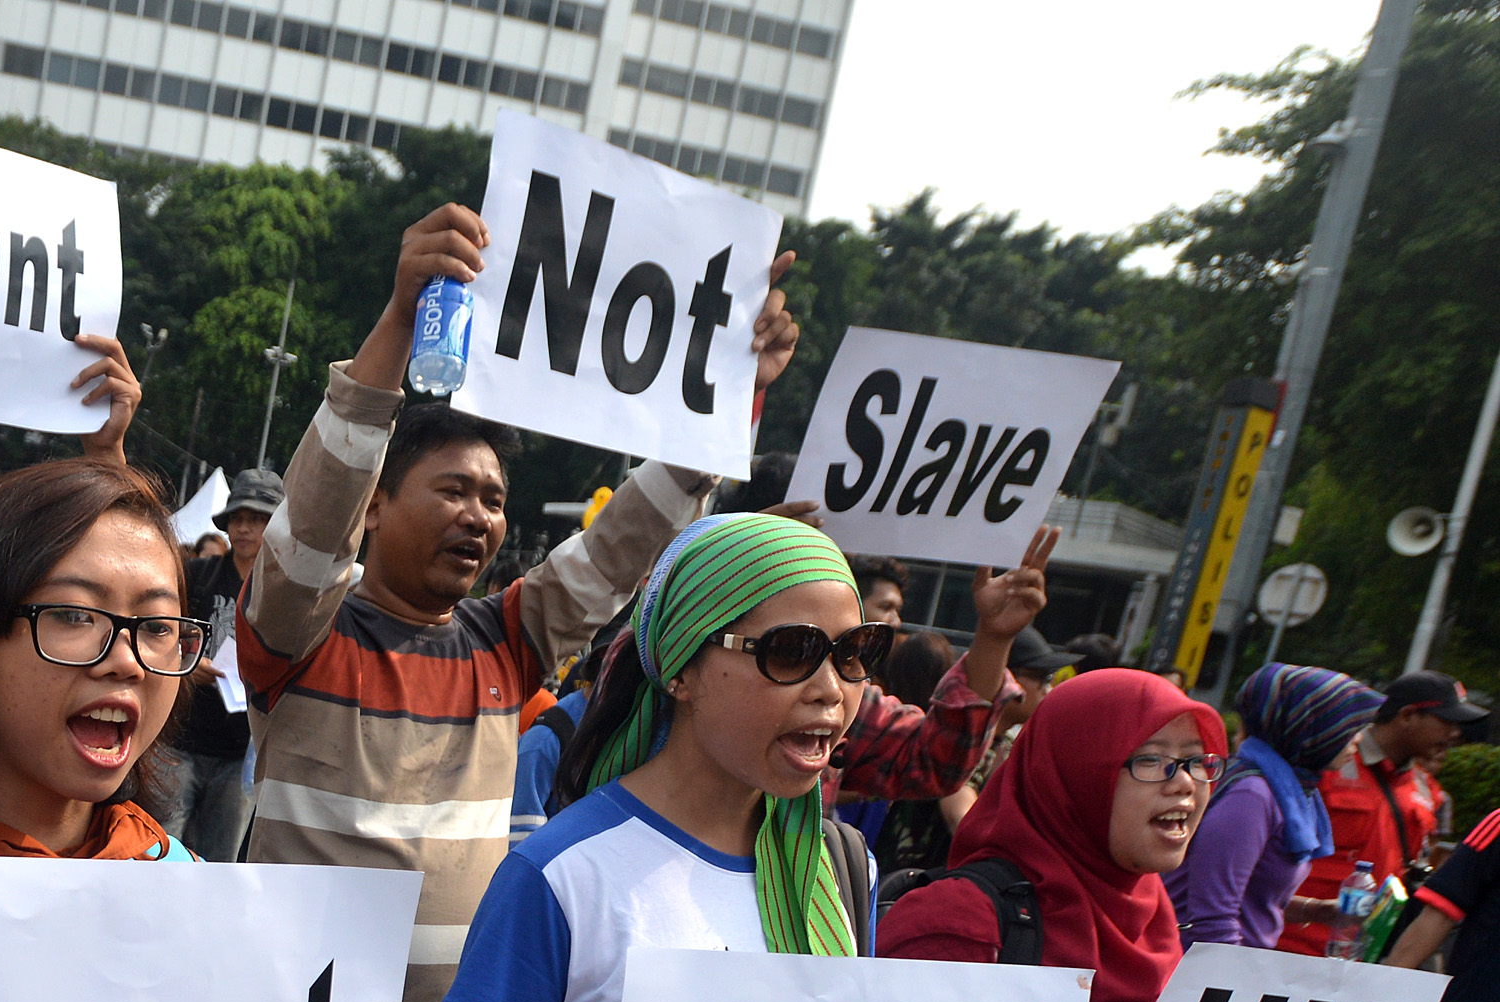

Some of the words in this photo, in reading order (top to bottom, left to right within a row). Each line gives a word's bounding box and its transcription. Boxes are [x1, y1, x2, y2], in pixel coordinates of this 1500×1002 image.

[495, 169, 734, 415] Not
[824, 369, 1051, 524] Slave
[1187, 430, 1263, 668] POLISI
